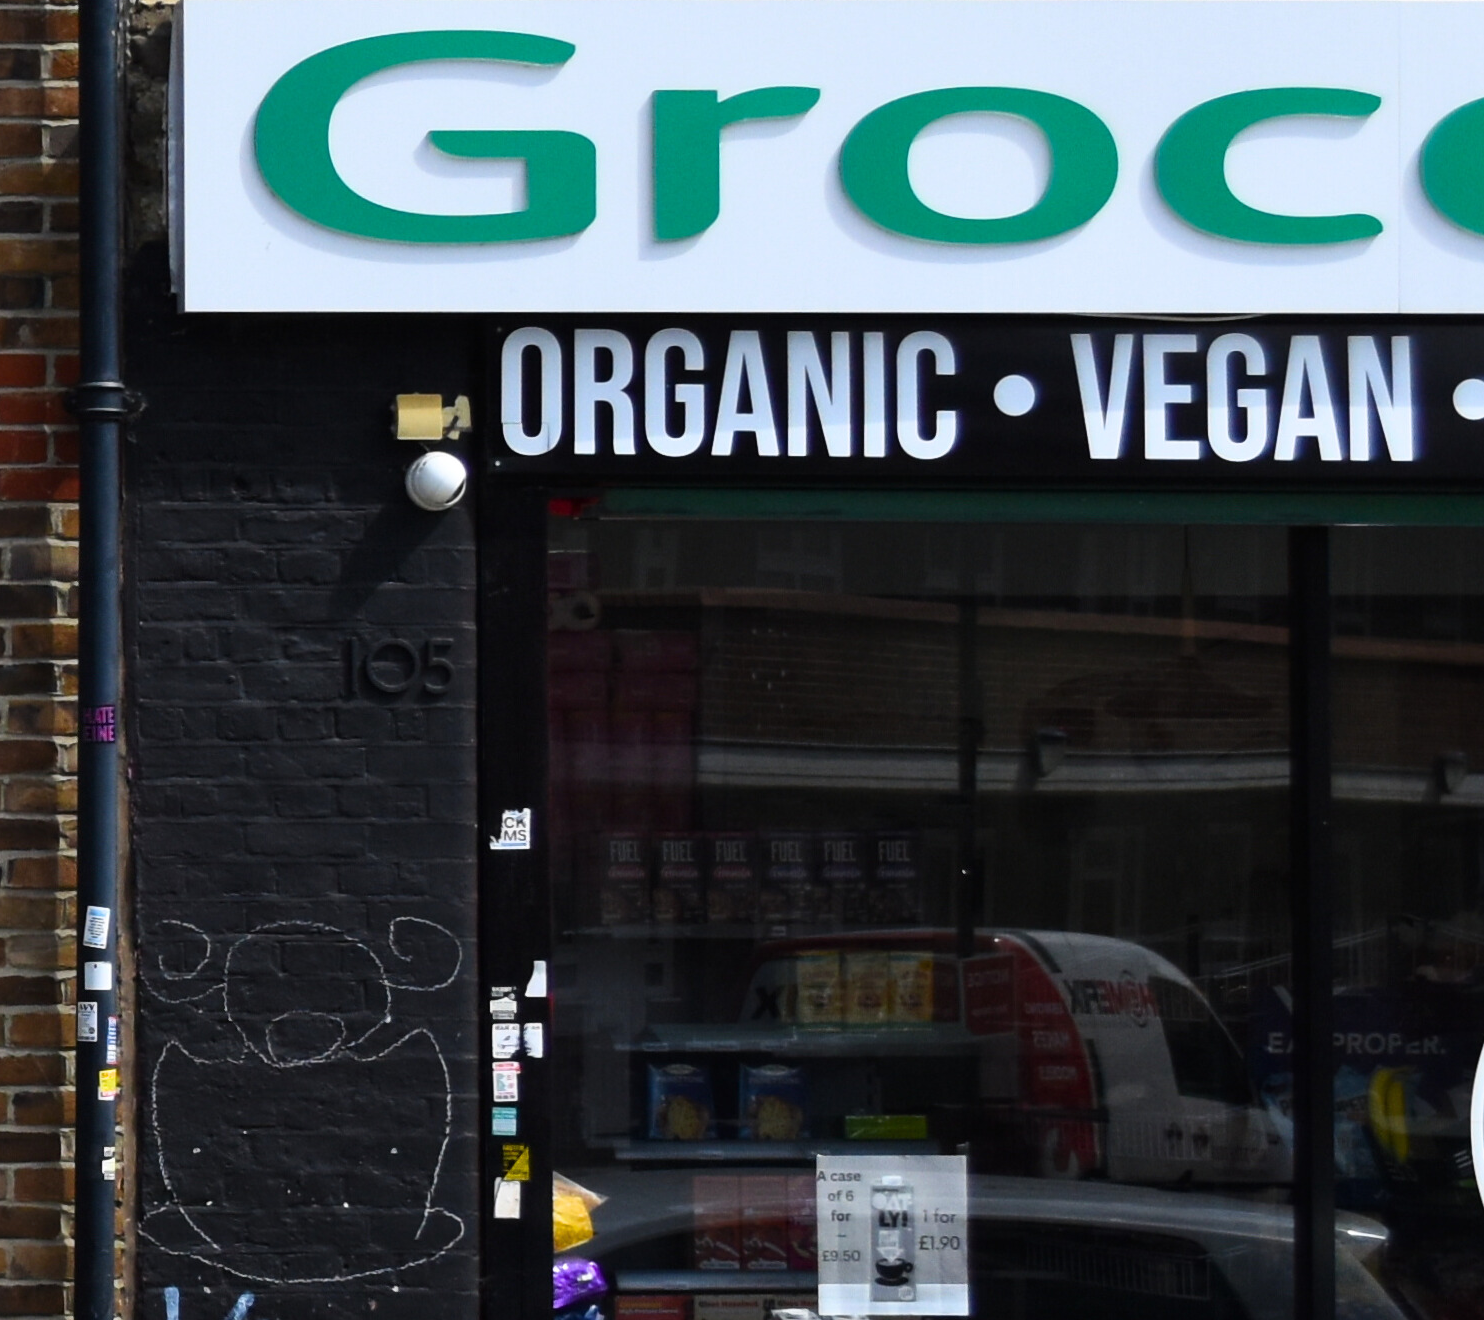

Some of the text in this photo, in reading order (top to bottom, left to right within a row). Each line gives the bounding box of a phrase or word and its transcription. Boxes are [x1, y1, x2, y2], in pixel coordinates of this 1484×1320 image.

[253, 29, 1484, 245] Groc
[501, 326, 1415, 463] ORGANIC VEGAN
[609, 839, 641, 863] FUEL
[662, 839, 695, 863] FUEL
[715, 839, 747, 863] FUEL
[770, 839, 803, 863] FUEL
[823, 839, 856, 863] FUEL
[878, 839, 910, 863] FUEL
[816, 1171, 862, 1182] A case
[827, 1190, 854, 1202] of 6
[830, 1210, 852, 1222] for
[878, 1211, 909, 1228] LY!
[922, 1209, 957, 1224] 1 for
[918, 1235, 961, 1252] £1.90
[821, 1249, 862, 1263] £9.50
